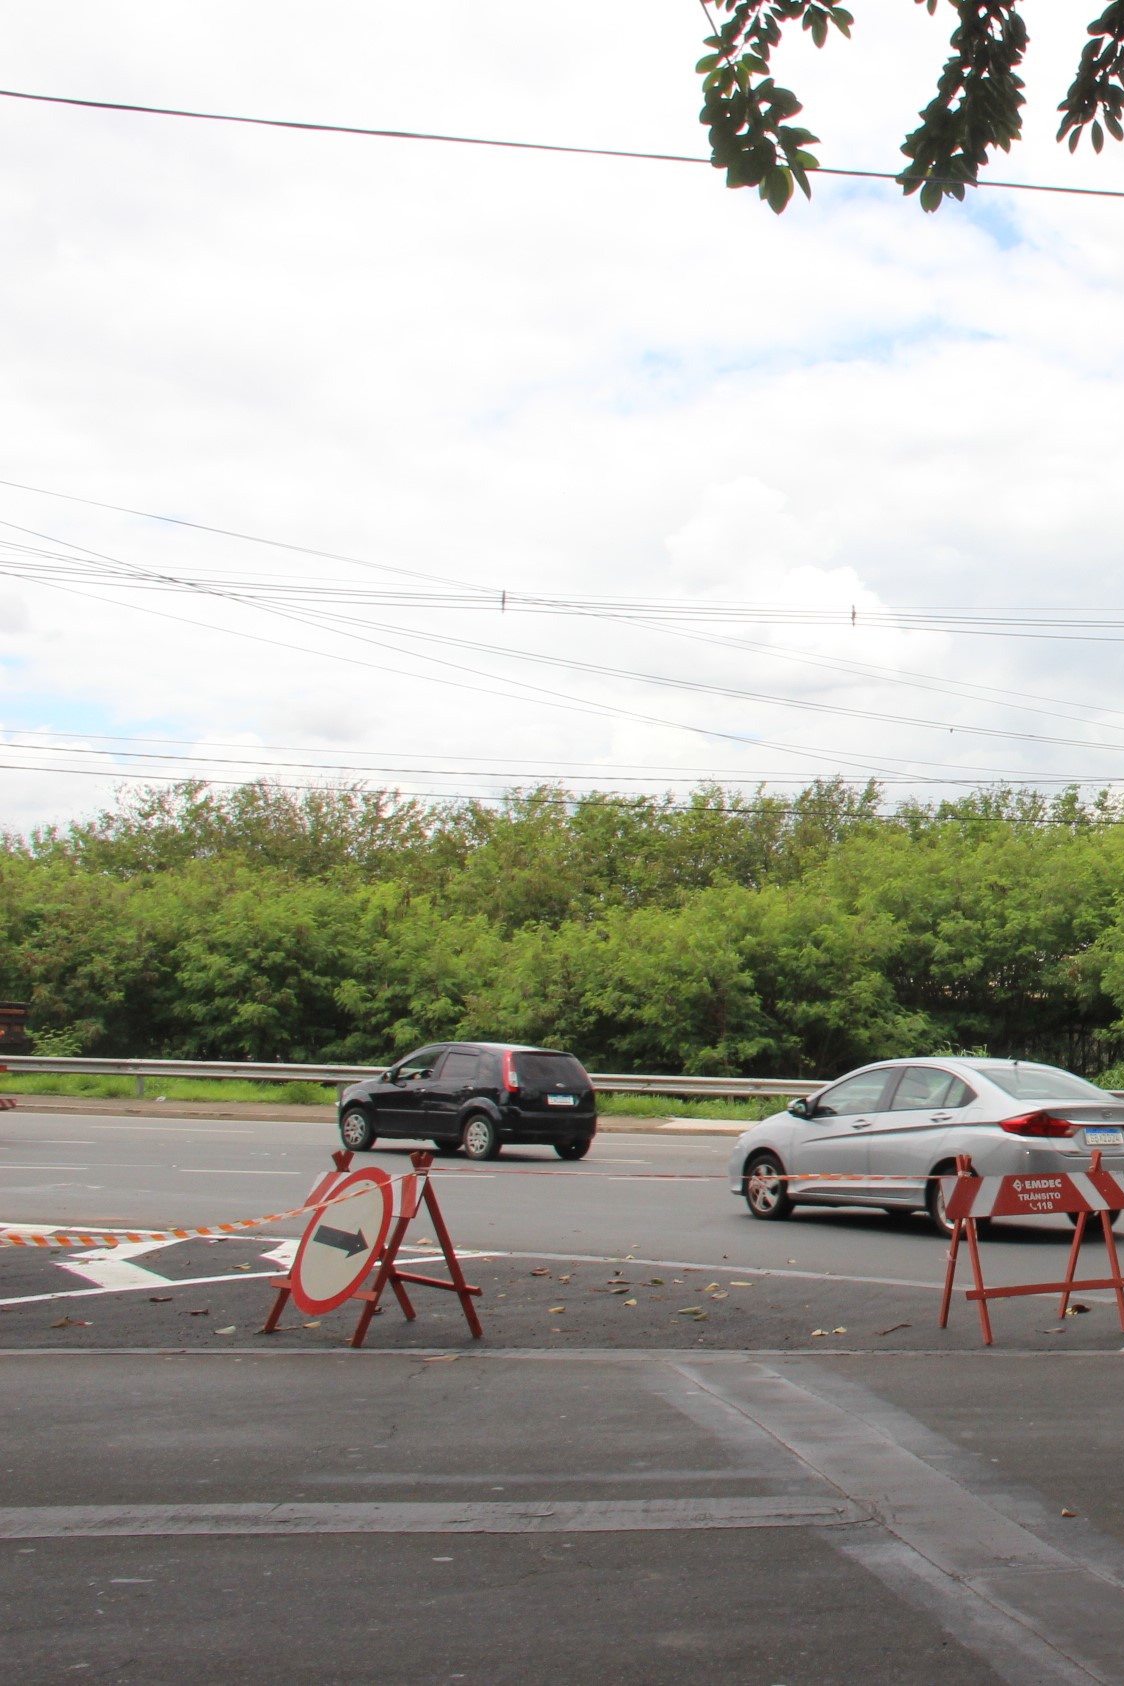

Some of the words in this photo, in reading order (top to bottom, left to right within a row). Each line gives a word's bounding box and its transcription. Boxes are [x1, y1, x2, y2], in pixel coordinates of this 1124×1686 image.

[1024, 1178, 1062, 1189] EMDEC
[1018, 1191, 1061, 1201] TRÂNSITO
[1036, 1201, 1053, 1210] 118
